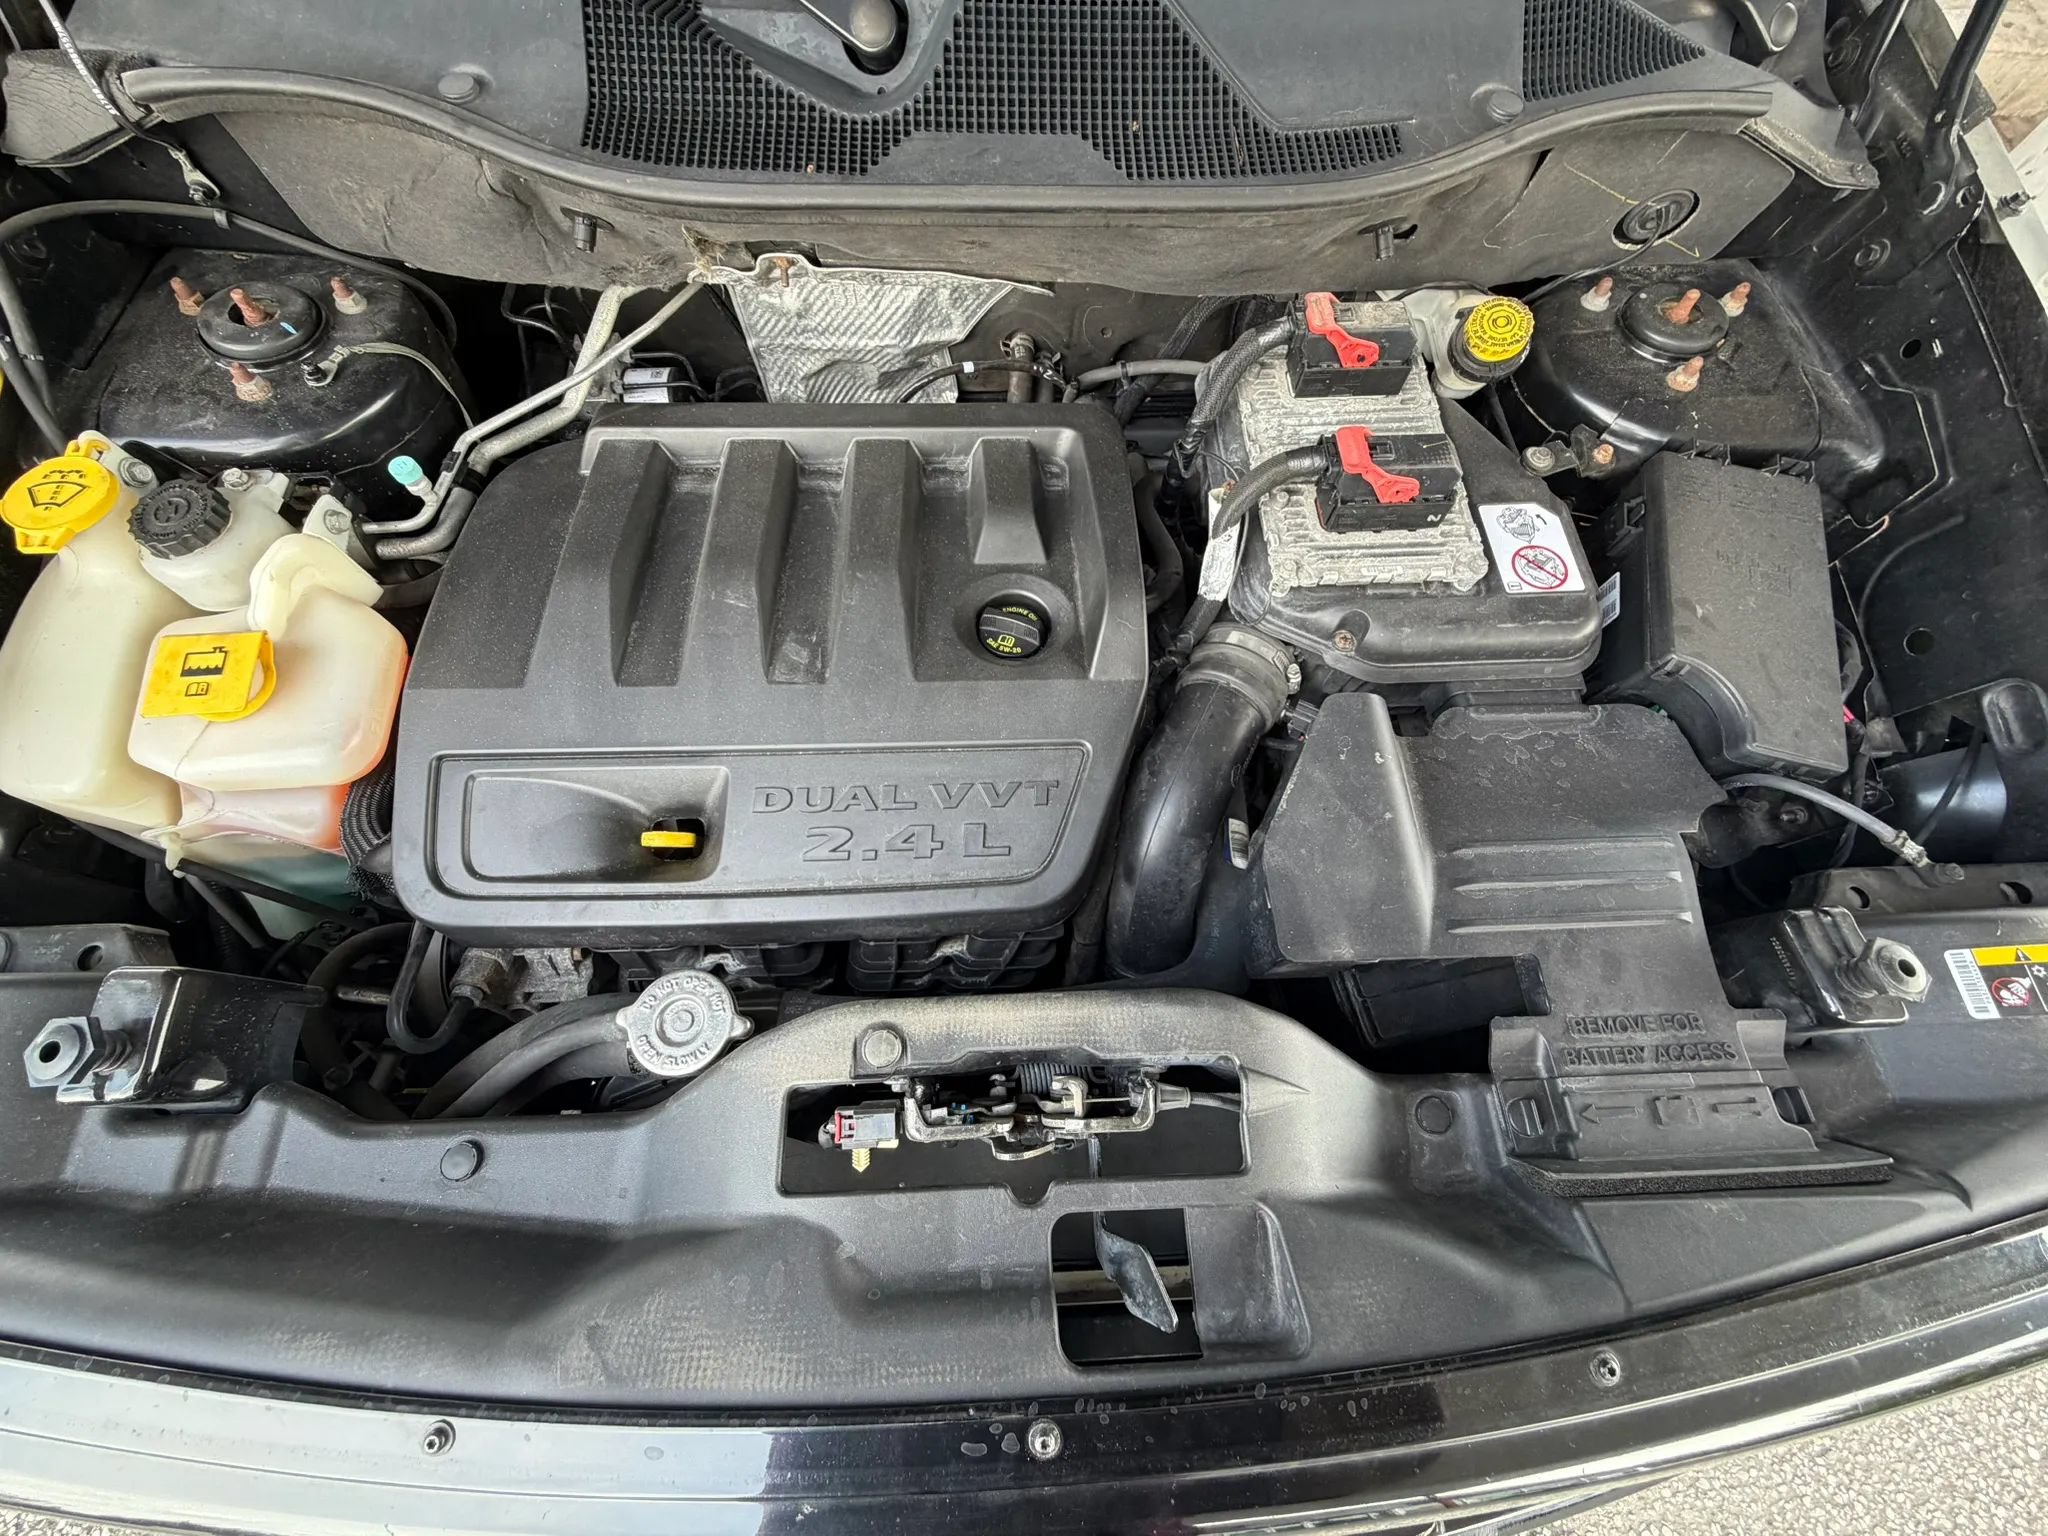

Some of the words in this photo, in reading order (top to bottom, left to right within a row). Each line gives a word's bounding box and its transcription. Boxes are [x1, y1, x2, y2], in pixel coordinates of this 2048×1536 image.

[1003, 607, 1028, 616] ENGINE
[1028, 612, 1038, 621] OIL
[987, 638, 999, 649] SAE
[999, 645, 1021, 654] 5W-20
[752, 785, 917, 813] DUAL
[928, 780, 1059, 809] VVT
[803, 824, 944, 862] 2.4
[962, 822, 1011, 857] L
[640, 994, 657, 1011] DO
[656, 977, 680, 998] NOT
[683, 975, 714, 996] OPEN
[709, 991, 726, 1013] HOT
[1571, 1014, 1655, 1035] REMOVE
[1659, 1012, 1704, 1033] FOR
[637, 1034, 665, 1064] OPEN
[663, 1042, 711, 1066] SLOWLY
[1564, 1045, 1651, 1067] BATTERY
[1655, 1041, 1740, 1063] ACCESS
